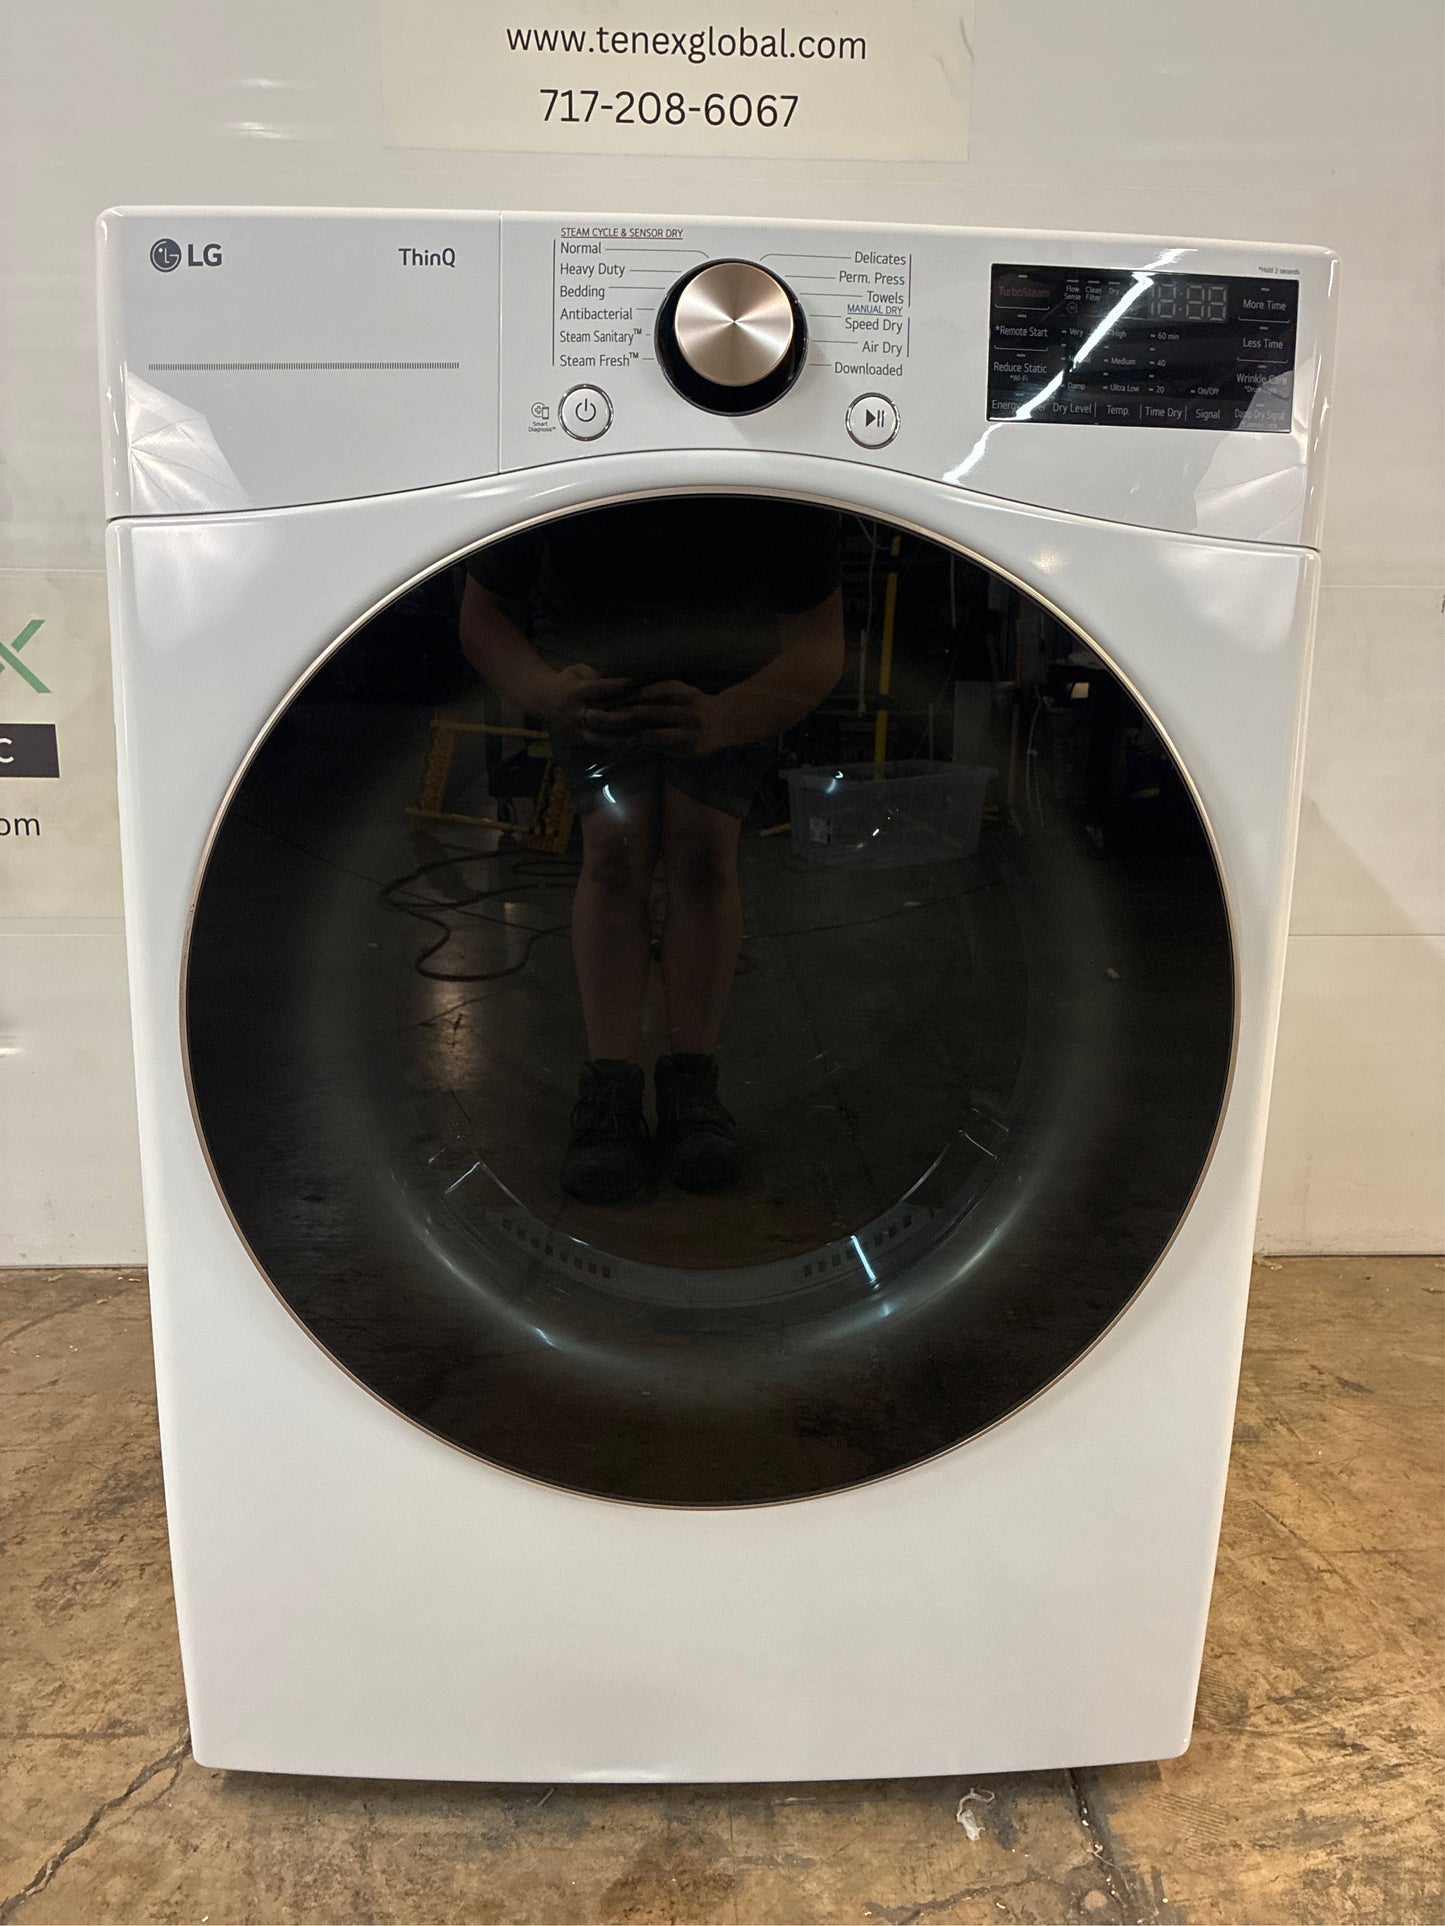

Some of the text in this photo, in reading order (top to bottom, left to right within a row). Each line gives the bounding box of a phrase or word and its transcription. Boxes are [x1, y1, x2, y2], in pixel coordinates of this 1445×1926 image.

[506, 26, 867, 64] www.tenexglobal.com
[539, 88, 799, 128] 717-208-6067
[561, 228, 683, 239] STEAM CYCLE & SENSOR DRY
[560, 242, 601, 254] Normal
[187, 243, 223, 267] LG
[398, 247, 457, 268] ThinQ
[855, 251, 906, 265] Delicates
[560, 263, 625, 278] Heavy Duty
[839, 271, 905, 285] Perm. Press
[560, 285, 605, 300] Bedding
[999, 286, 1050, 297] TurboSteam
[1085, 286, 1102, 294] Clean
[1109, 287, 1119, 296] Dry
[867, 291, 904, 304] Towels
[847, 304, 903, 315] MANUAL DRY
[1243, 299, 1287, 311] More Time
[560, 308, 632, 320] Antibacterial
[845, 318, 902, 334] Speed Dry
[1029, 327, 1048, 337] Start
[560, 331, 590, 342] Steam
[1069, 328, 1083, 337] Very
[1158, 332, 1167, 340] 60
[862, 341, 902, 356] Air Dry
[1243, 337, 1284, 349] Less Time
[560, 354, 595, 366] Steam
[1111, 357, 1136, 365] Medium
[1157, 359, 1166, 367] 40
[834, 362, 903, 376] Downloaded
[993, 361, 1047, 374] Reduce Static
[1236, 373, 1288, 385] Wrinkle Care
[1068, 382, 1085, 390] Damp
[1111, 384, 1126, 392] Ultra
[1156, 386, 1165, 394] 20
[1198, 386, 1219, 396] On/Off
[1053, 402, 1068, 413] Dry
[1070, 403, 1092, 414] Level
[1107, 404, 1130, 417] Temp.
[1145, 406, 1182, 419] Time Dry
[1196, 408, 1220, 420] Signal
